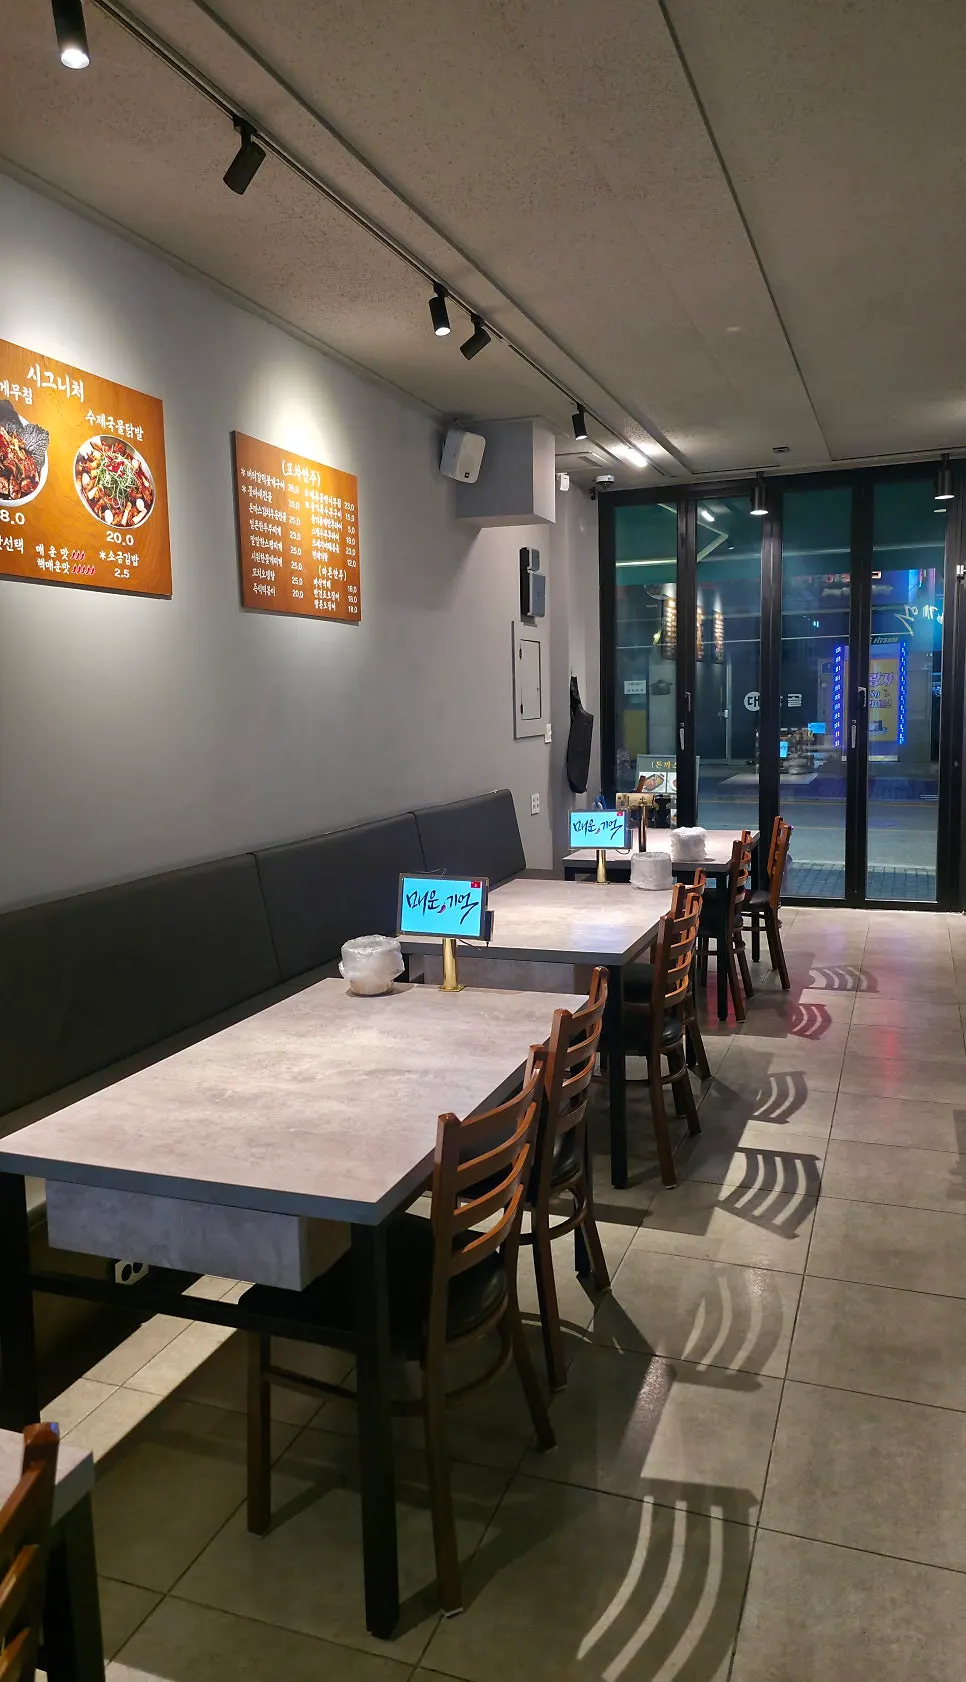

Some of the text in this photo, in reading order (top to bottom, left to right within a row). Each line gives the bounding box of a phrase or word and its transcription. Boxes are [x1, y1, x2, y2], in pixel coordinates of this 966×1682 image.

[27, 363, 84, 403] 시그니처
[85, 409, 144, 441] 수제국물닭발
[0, 509, 25, 525] 8.0
[106, 531, 134, 546] 20.0
[114, 568, 130, 579] 2.5
[446, 892, 479, 925] 기억
